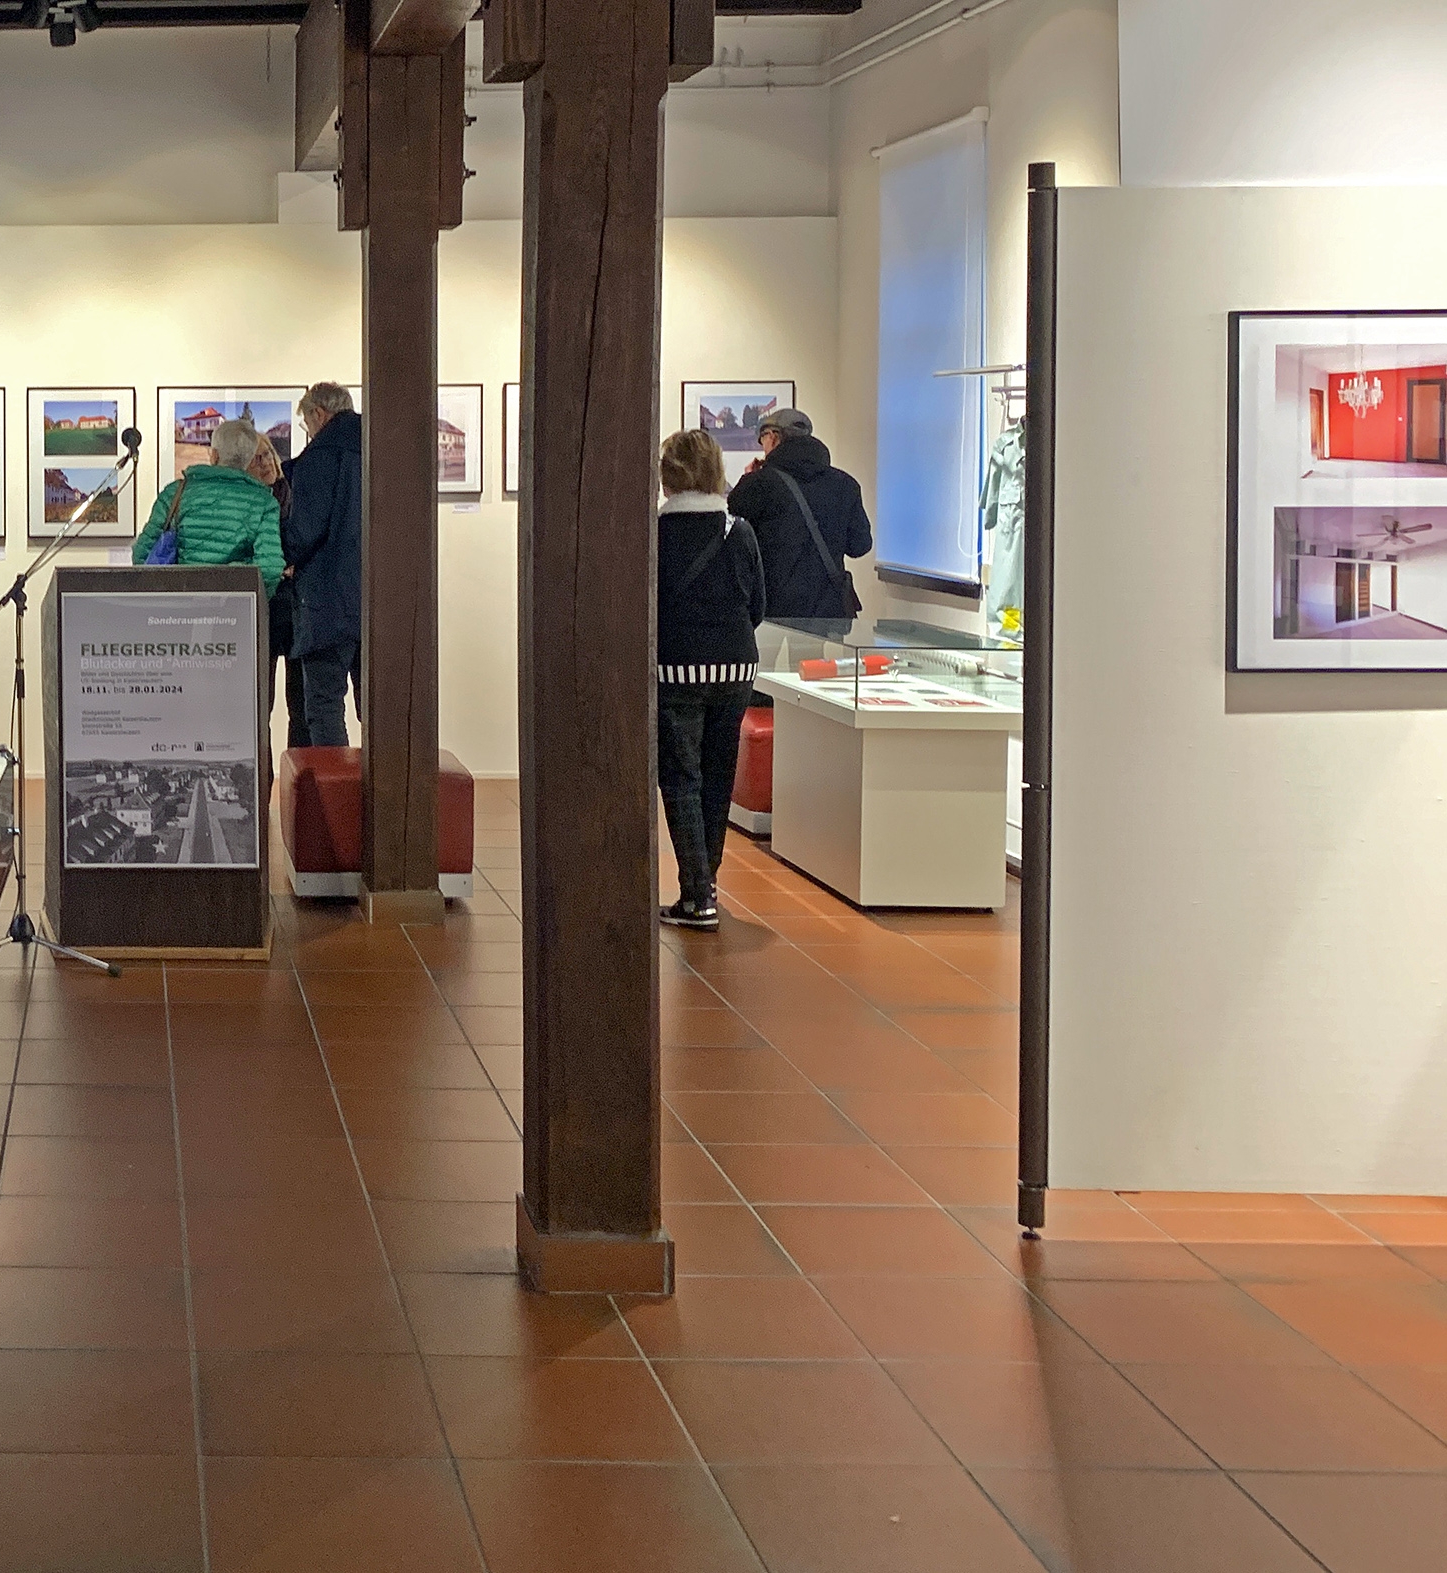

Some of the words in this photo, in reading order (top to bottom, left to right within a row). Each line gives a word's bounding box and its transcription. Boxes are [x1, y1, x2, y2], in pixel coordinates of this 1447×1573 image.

[147, 616, 237, 627] Sonderausstellung
[80, 643, 237, 657] FLIEGERSTRASSE
[80, 657, 137, 670] Blutacker
[140, 658, 163, 669] und
[81, 686, 110, 694] 18.11.
[113, 686, 126, 694] bis
[129, 686, 183, 694] 28.01.2024
